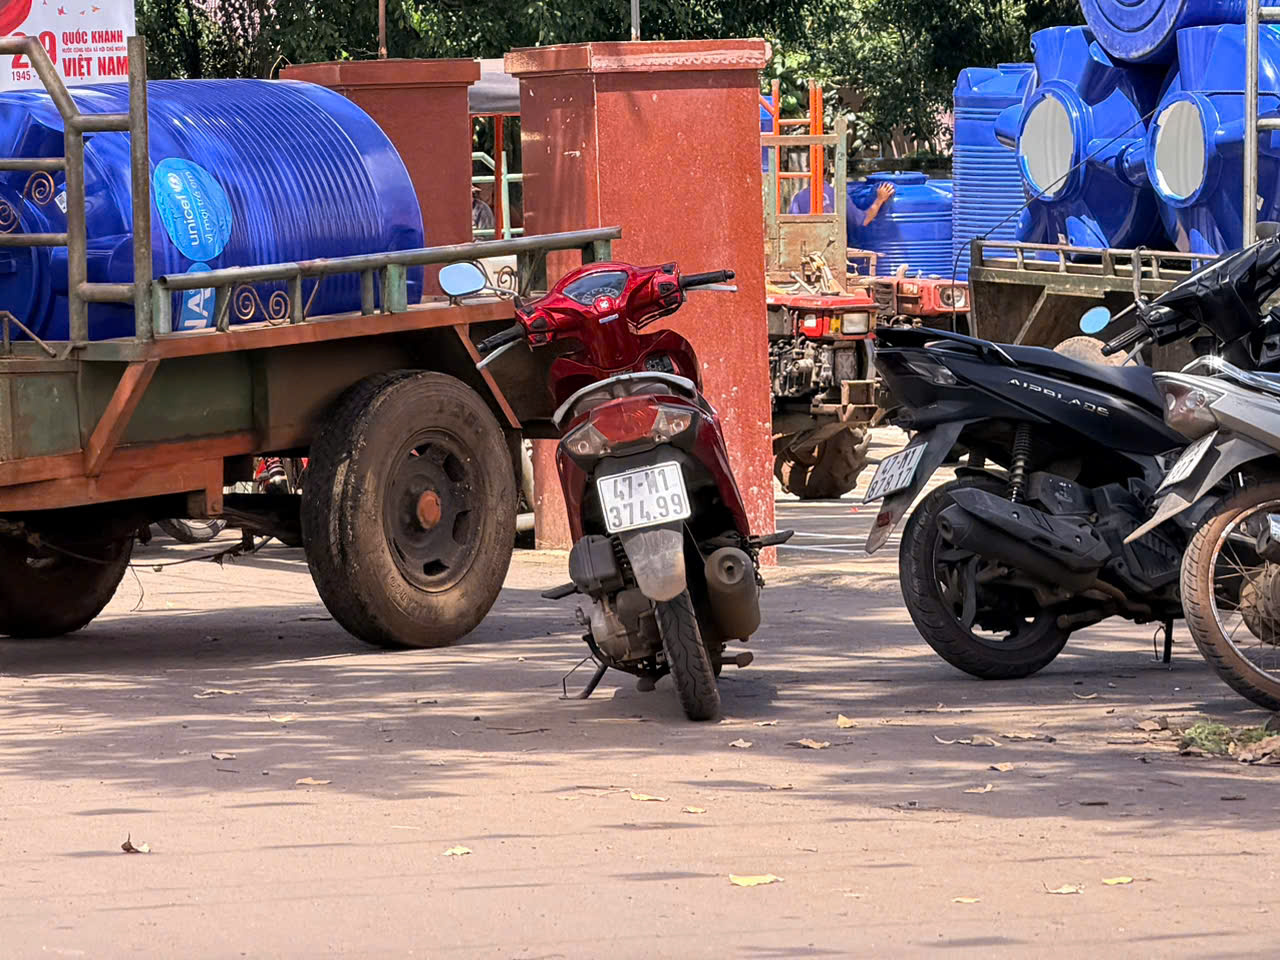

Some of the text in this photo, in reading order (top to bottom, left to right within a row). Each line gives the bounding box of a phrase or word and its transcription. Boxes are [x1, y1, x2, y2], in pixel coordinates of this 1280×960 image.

[62, 27, 123, 46] QUỐC KHÁNH
[12, 70, 31, 81] 1945
[62, 53, 129, 80] VIỆT NAM
[175, 193, 200, 246] unicef
[613, 468, 669, 501] 47-M1
[609, 493, 684, 528] 374.99
